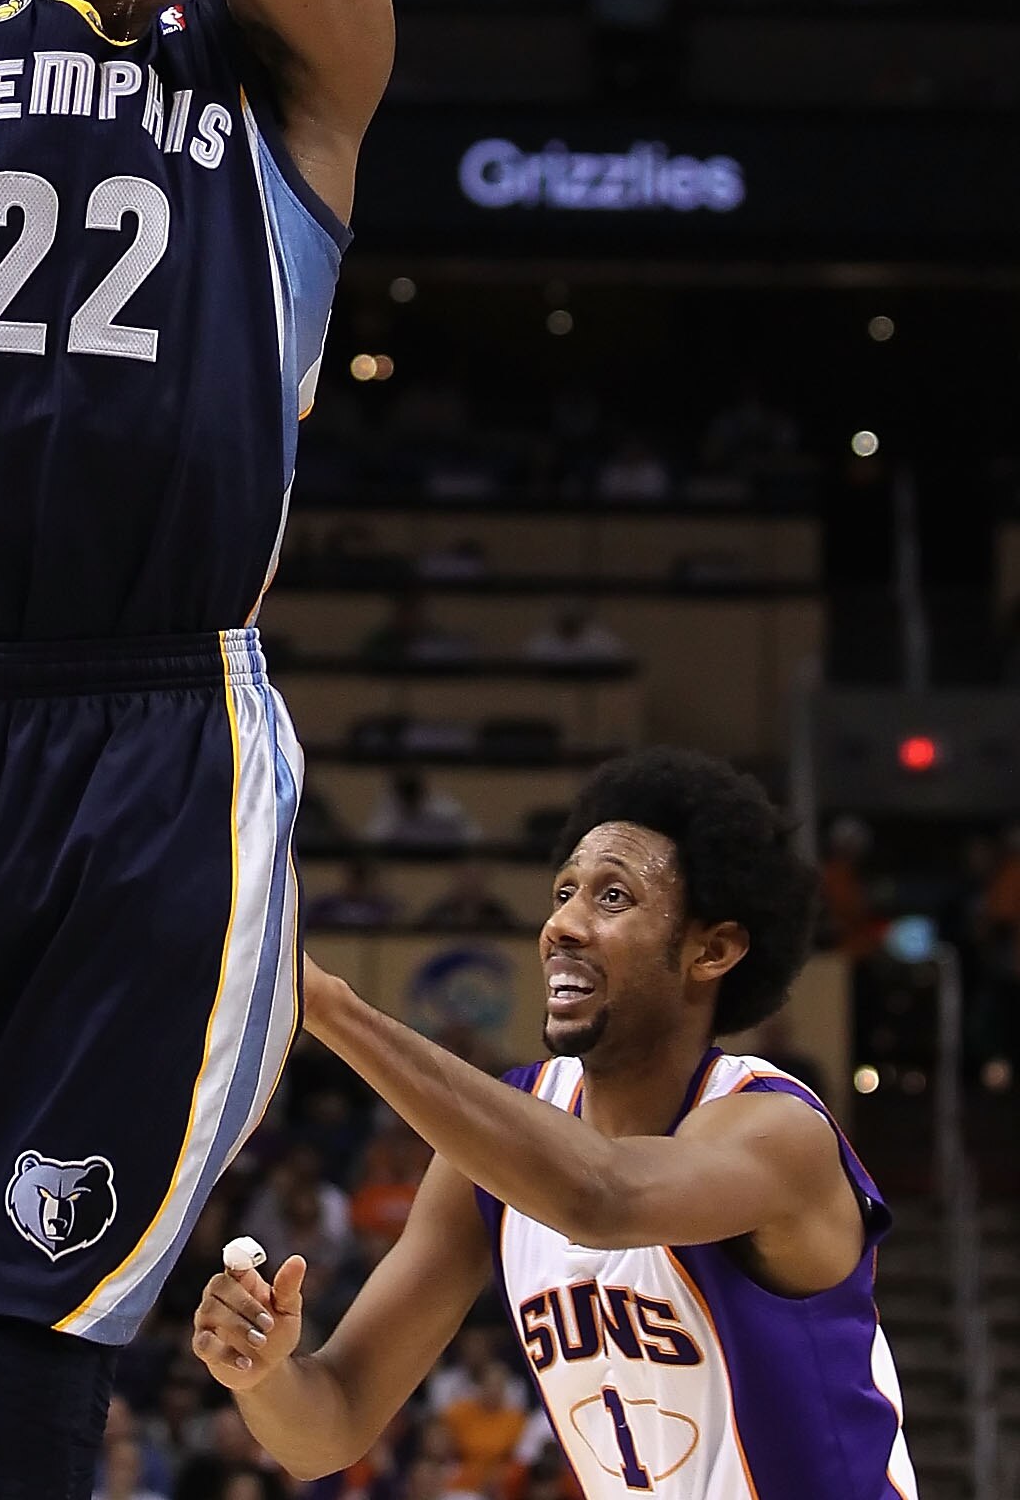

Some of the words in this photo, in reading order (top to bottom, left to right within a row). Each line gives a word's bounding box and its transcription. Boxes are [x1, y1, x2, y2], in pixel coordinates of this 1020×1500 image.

[458, 139, 744, 211] Grizzlies
[520, 1279, 705, 1372] SUNS
[601, 1385, 654, 1492] 1
